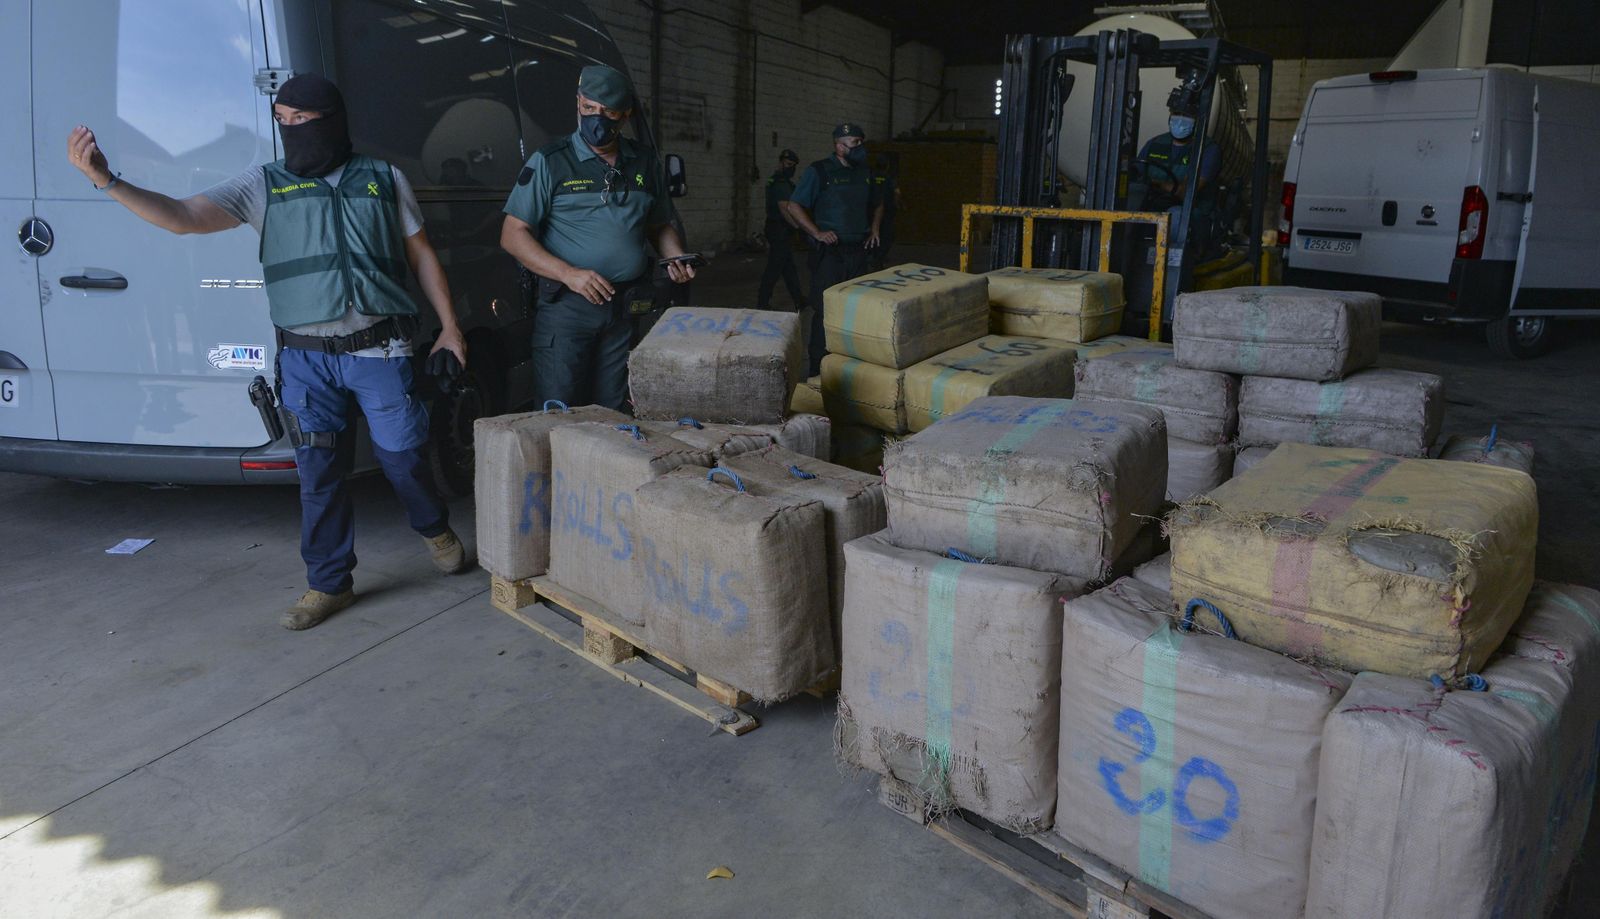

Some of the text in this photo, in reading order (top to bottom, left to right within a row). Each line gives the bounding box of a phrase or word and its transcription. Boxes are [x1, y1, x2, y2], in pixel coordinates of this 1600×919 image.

[271, 181, 318, 194] GUARDIA CIVIL
[1309, 239, 1353, 252] 2524 JSG
[231, 347, 263, 360] AVIC
